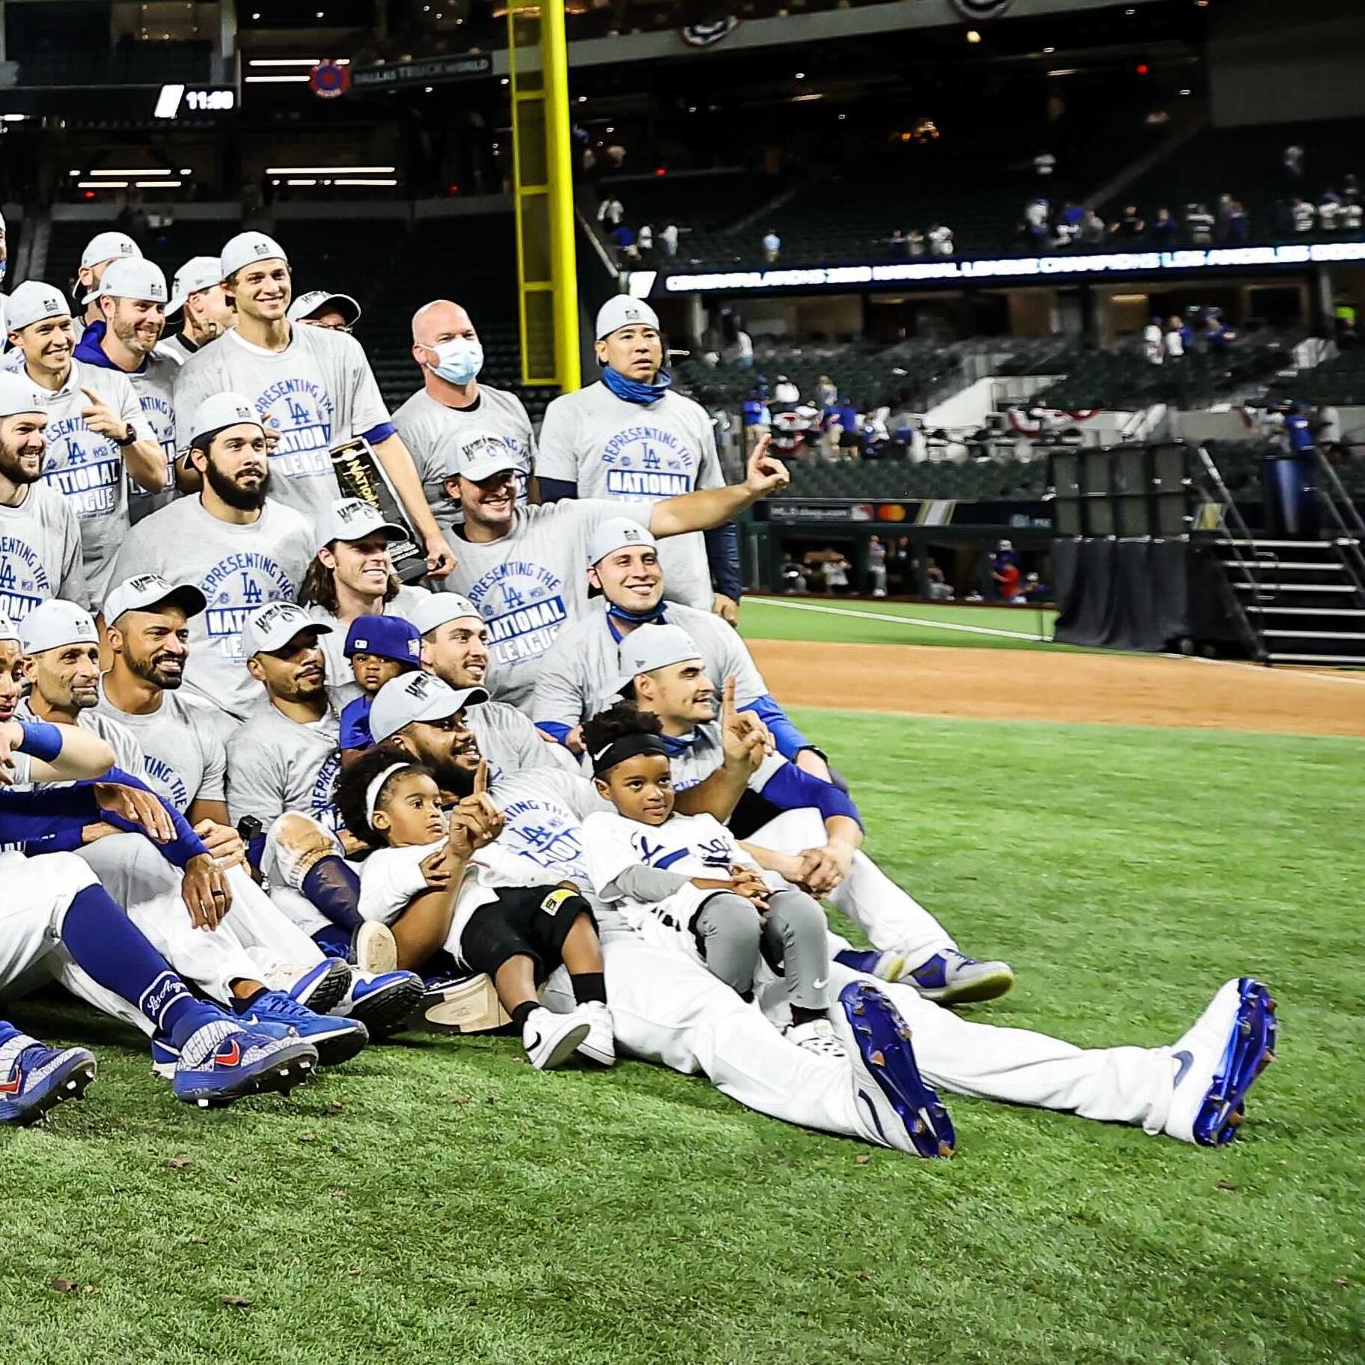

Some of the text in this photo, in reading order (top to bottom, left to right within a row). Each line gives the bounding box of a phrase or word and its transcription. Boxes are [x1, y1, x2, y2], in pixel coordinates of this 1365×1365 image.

[285, 397, 312, 425] LA
[68, 437, 87, 465] LA
[602, 426, 678, 465] REPRESENTING
[641, 441, 661, 469] LA
[609, 470, 688, 496] NATIONAL
[33, 563, 50, 592] THE
[241, 571, 263, 604] LA
[276, 570, 296, 601] THE
[538, 565, 561, 591] THE
[502, 583, 524, 609] LA
[169, 777, 188, 809] THE
